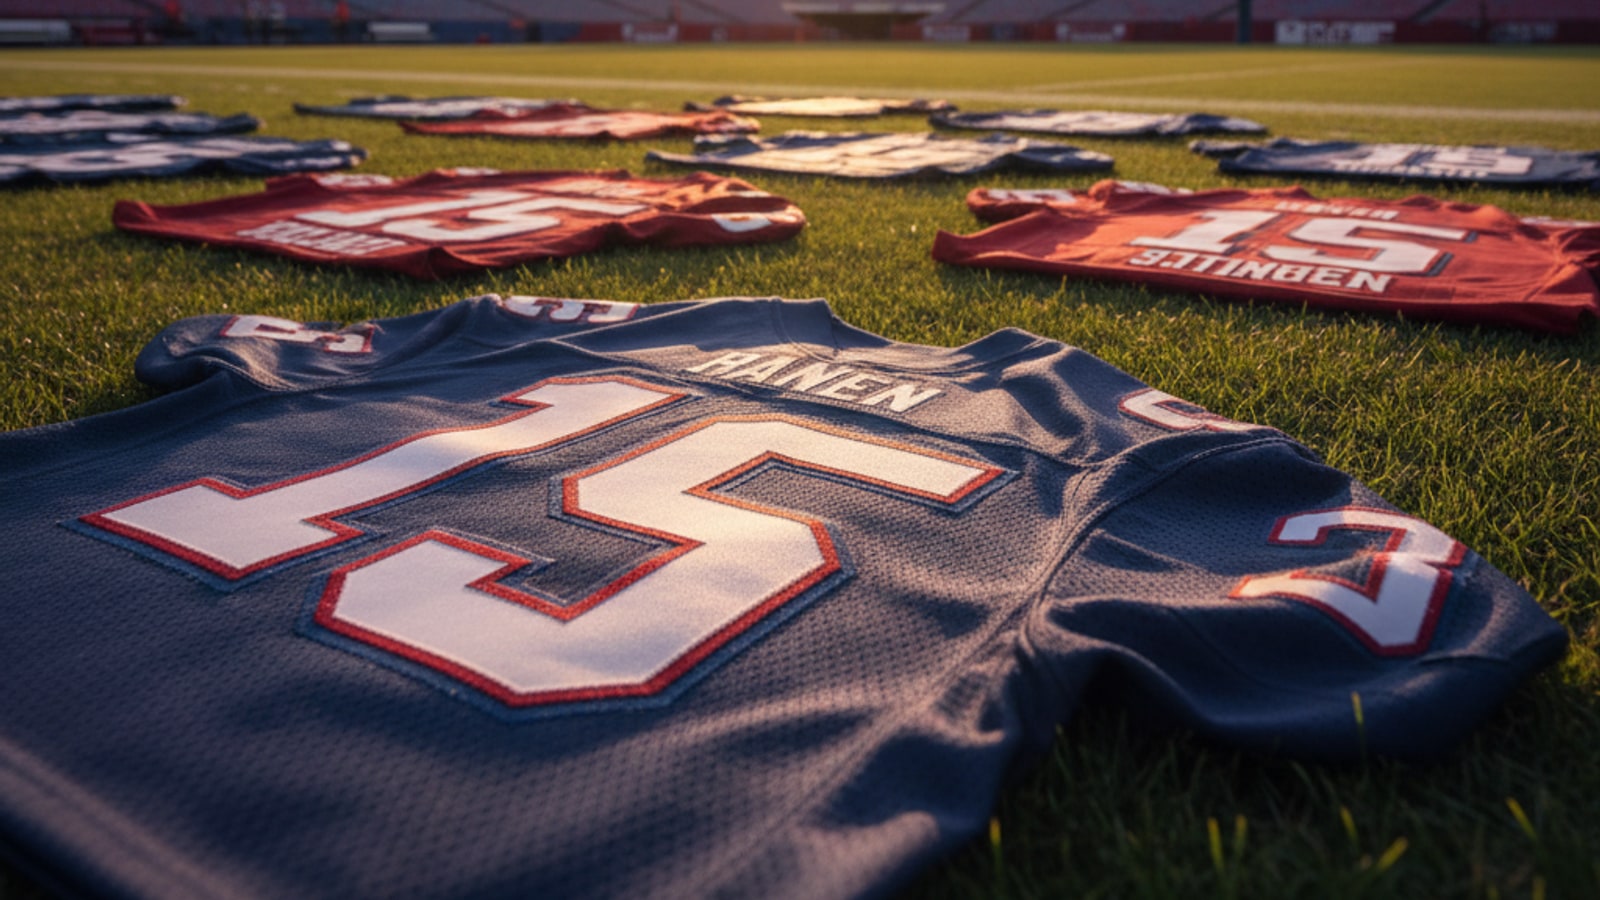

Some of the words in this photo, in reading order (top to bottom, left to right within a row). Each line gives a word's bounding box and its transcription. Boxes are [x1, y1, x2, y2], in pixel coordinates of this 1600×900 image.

[296, 191, 648, 241] 15
[1128, 209, 1472, 275] 15
[76, 374, 1008, 710] 15
